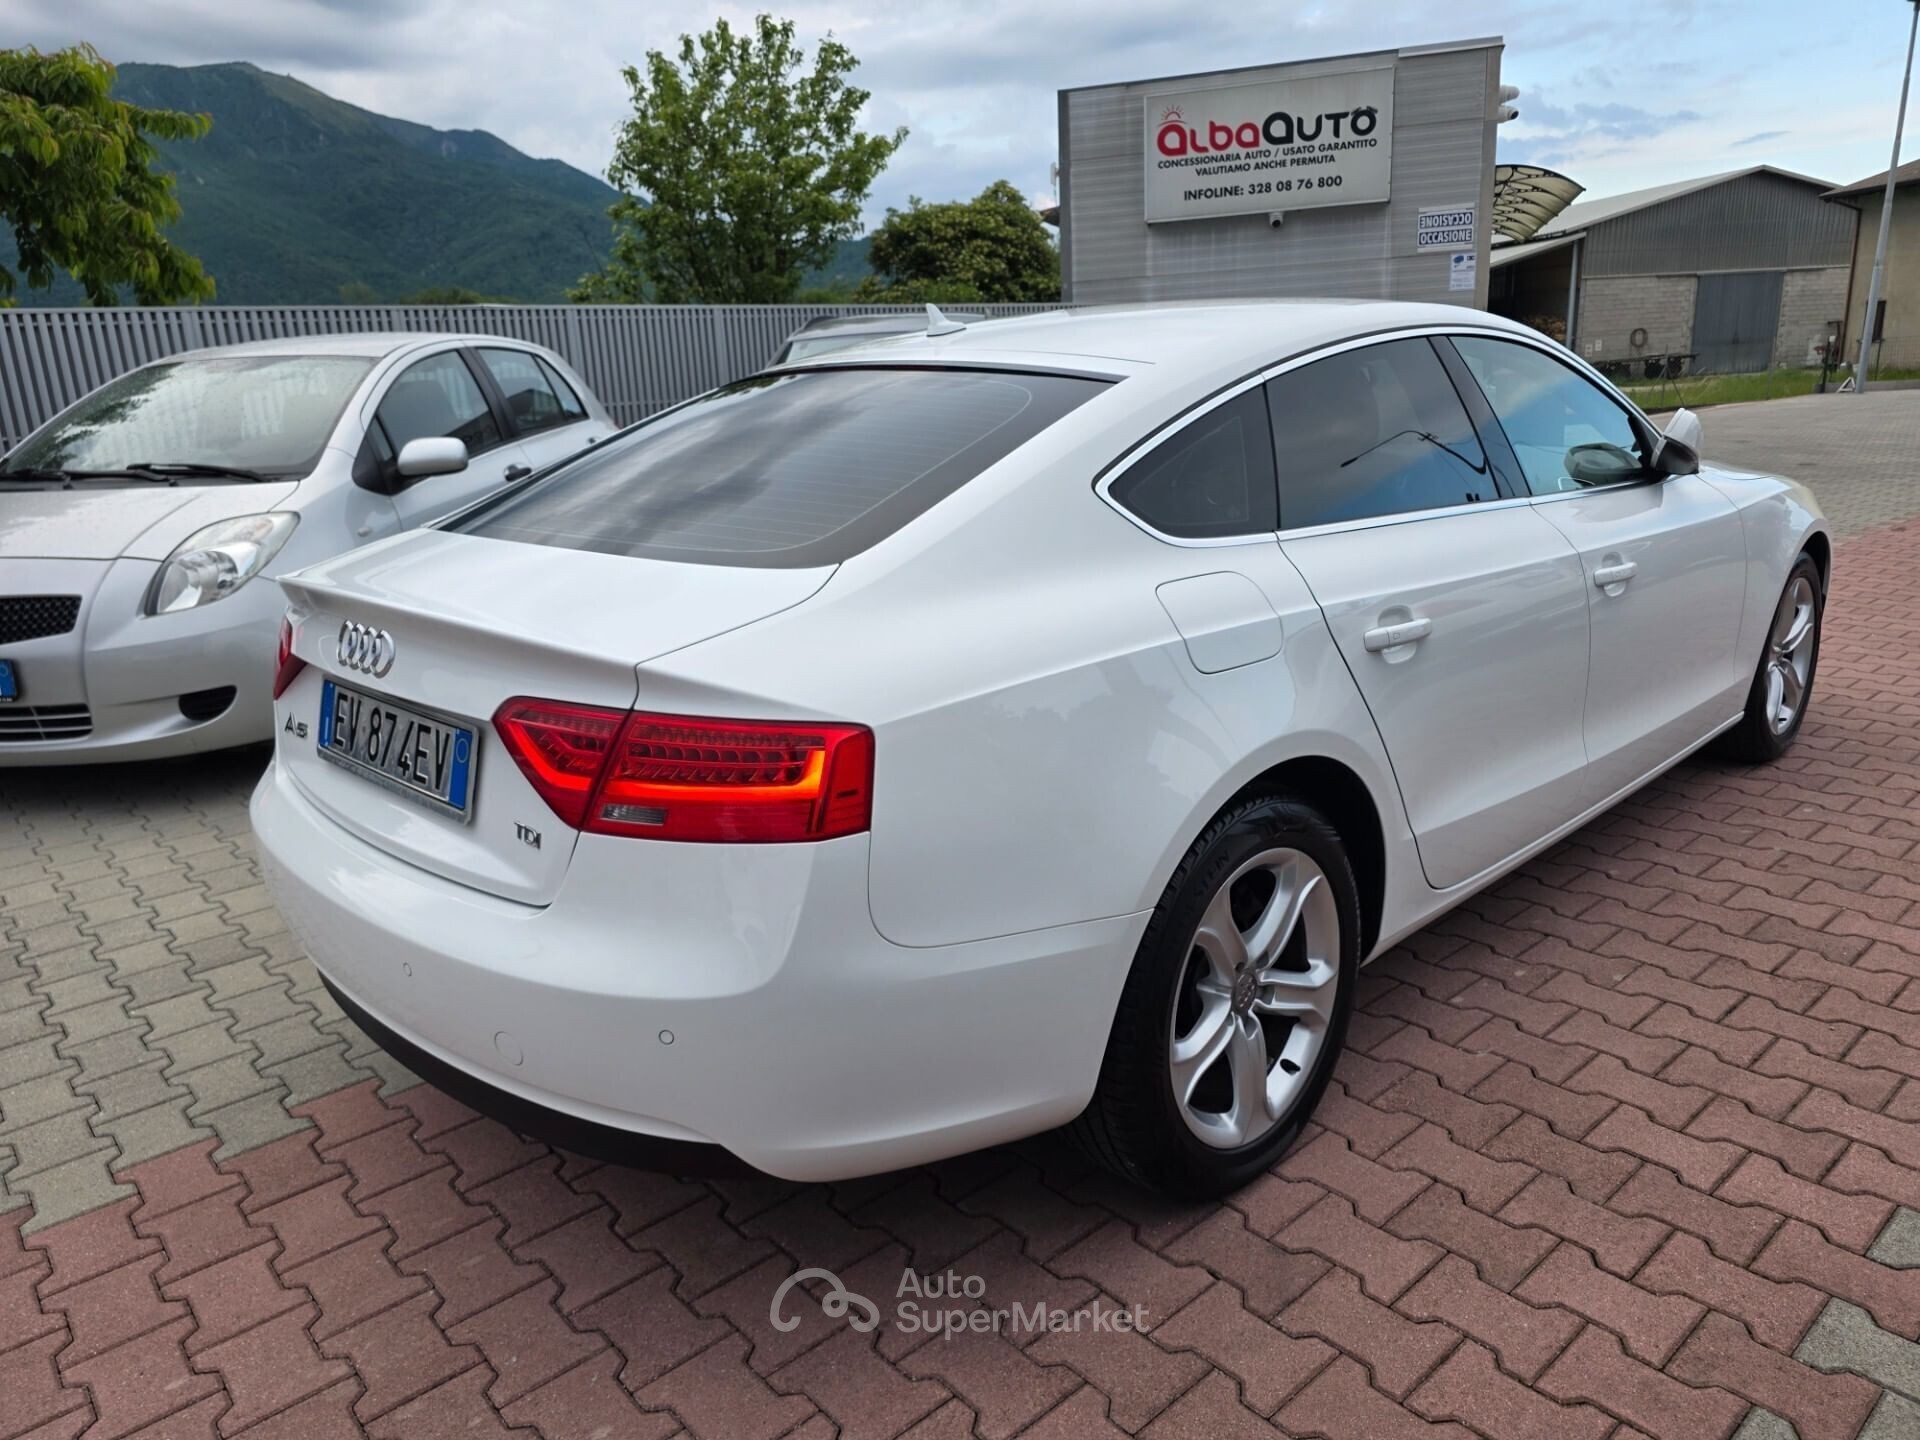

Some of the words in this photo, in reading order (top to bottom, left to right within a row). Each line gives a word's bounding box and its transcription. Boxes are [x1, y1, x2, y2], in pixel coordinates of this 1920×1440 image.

[1158, 153, 1241, 169] CONCESSIONARIA
[1244, 149, 1271, 160] AUTO
[1282, 145, 1315, 156] USATO
[1318, 138, 1377, 153] GARANTITO
[1195, 163, 1251, 176] VALUTIAMO
[1253, 159, 1287, 171] ANCHE
[1290, 154, 1336, 167] PERMUTA
[1184, 185, 1244, 200] INFOLINE:
[1248, 182, 1272, 195] 328
[1276, 180, 1292, 192] 08
[1297, 178, 1313, 190] 76
[1317, 175, 1342, 188] 800
[1420, 212, 1472, 228] OCCASIONE
[1420, 229, 1472, 244] OCCASIONE
[284, 711, 308, 738] A5
[333, 691, 362, 749] EV
[514, 821, 542, 850] TDI
